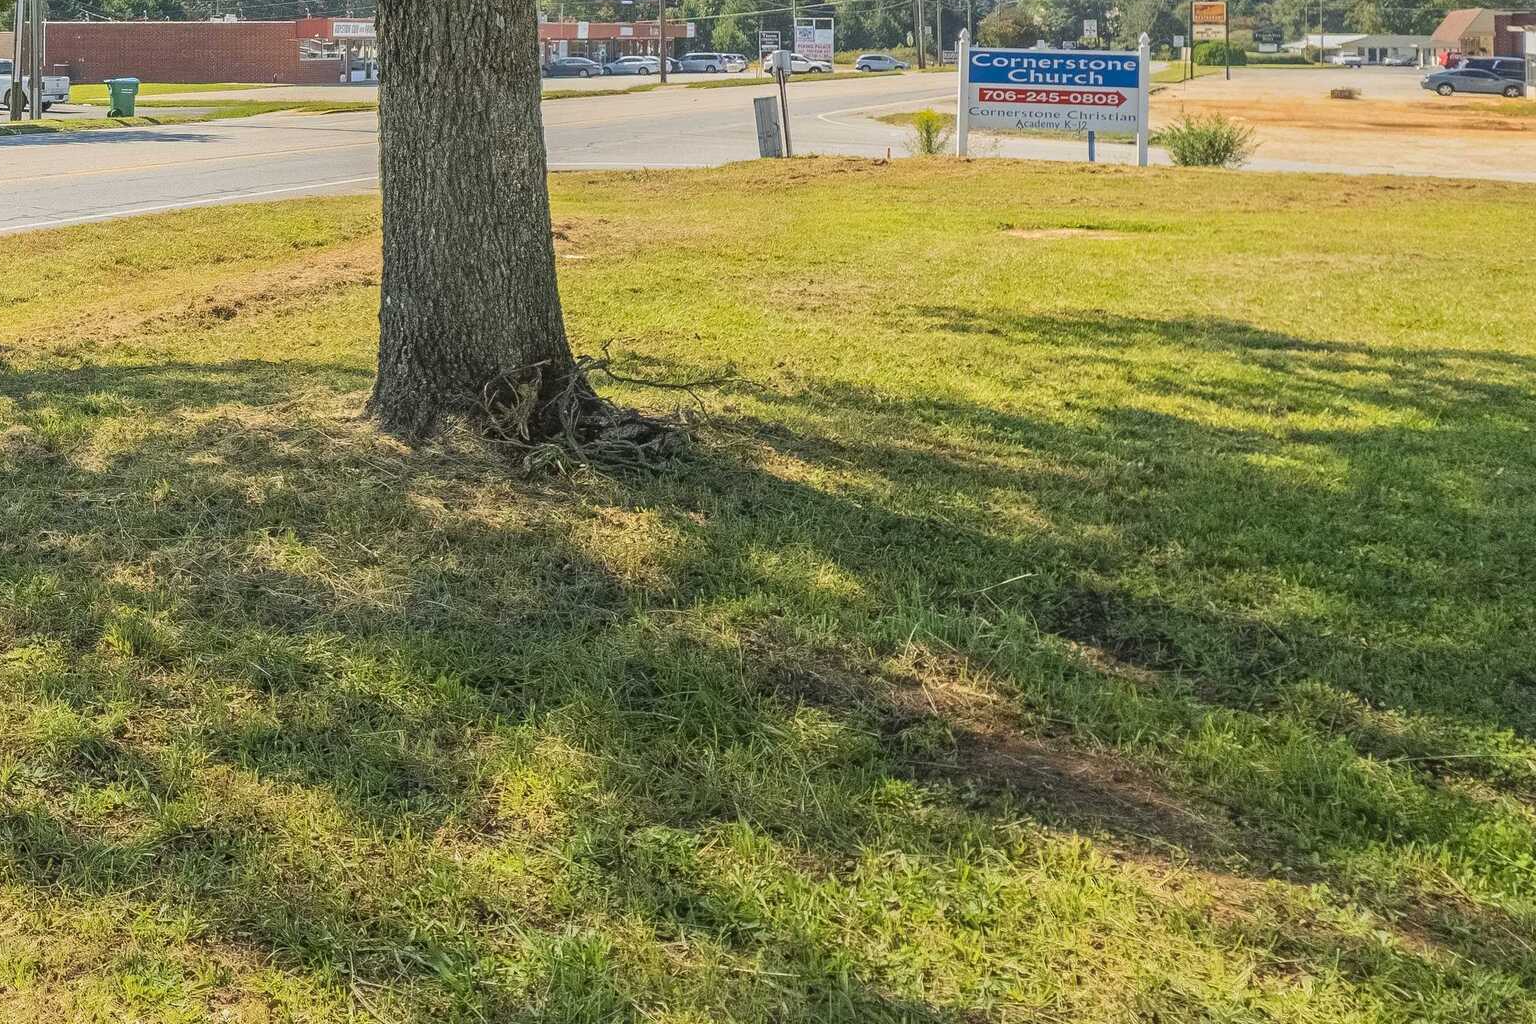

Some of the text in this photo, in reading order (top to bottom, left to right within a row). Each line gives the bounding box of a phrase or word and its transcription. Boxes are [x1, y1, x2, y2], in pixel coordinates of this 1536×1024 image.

[971, 53, 1137, 71] Cornerstone
[1007, 69, 1104, 85] Church
[983, 89, 1120, 105] 706-245-0808
[968, 106, 1137, 122] Cornerstone Christian
[1016, 120, 1060, 130] Academy
